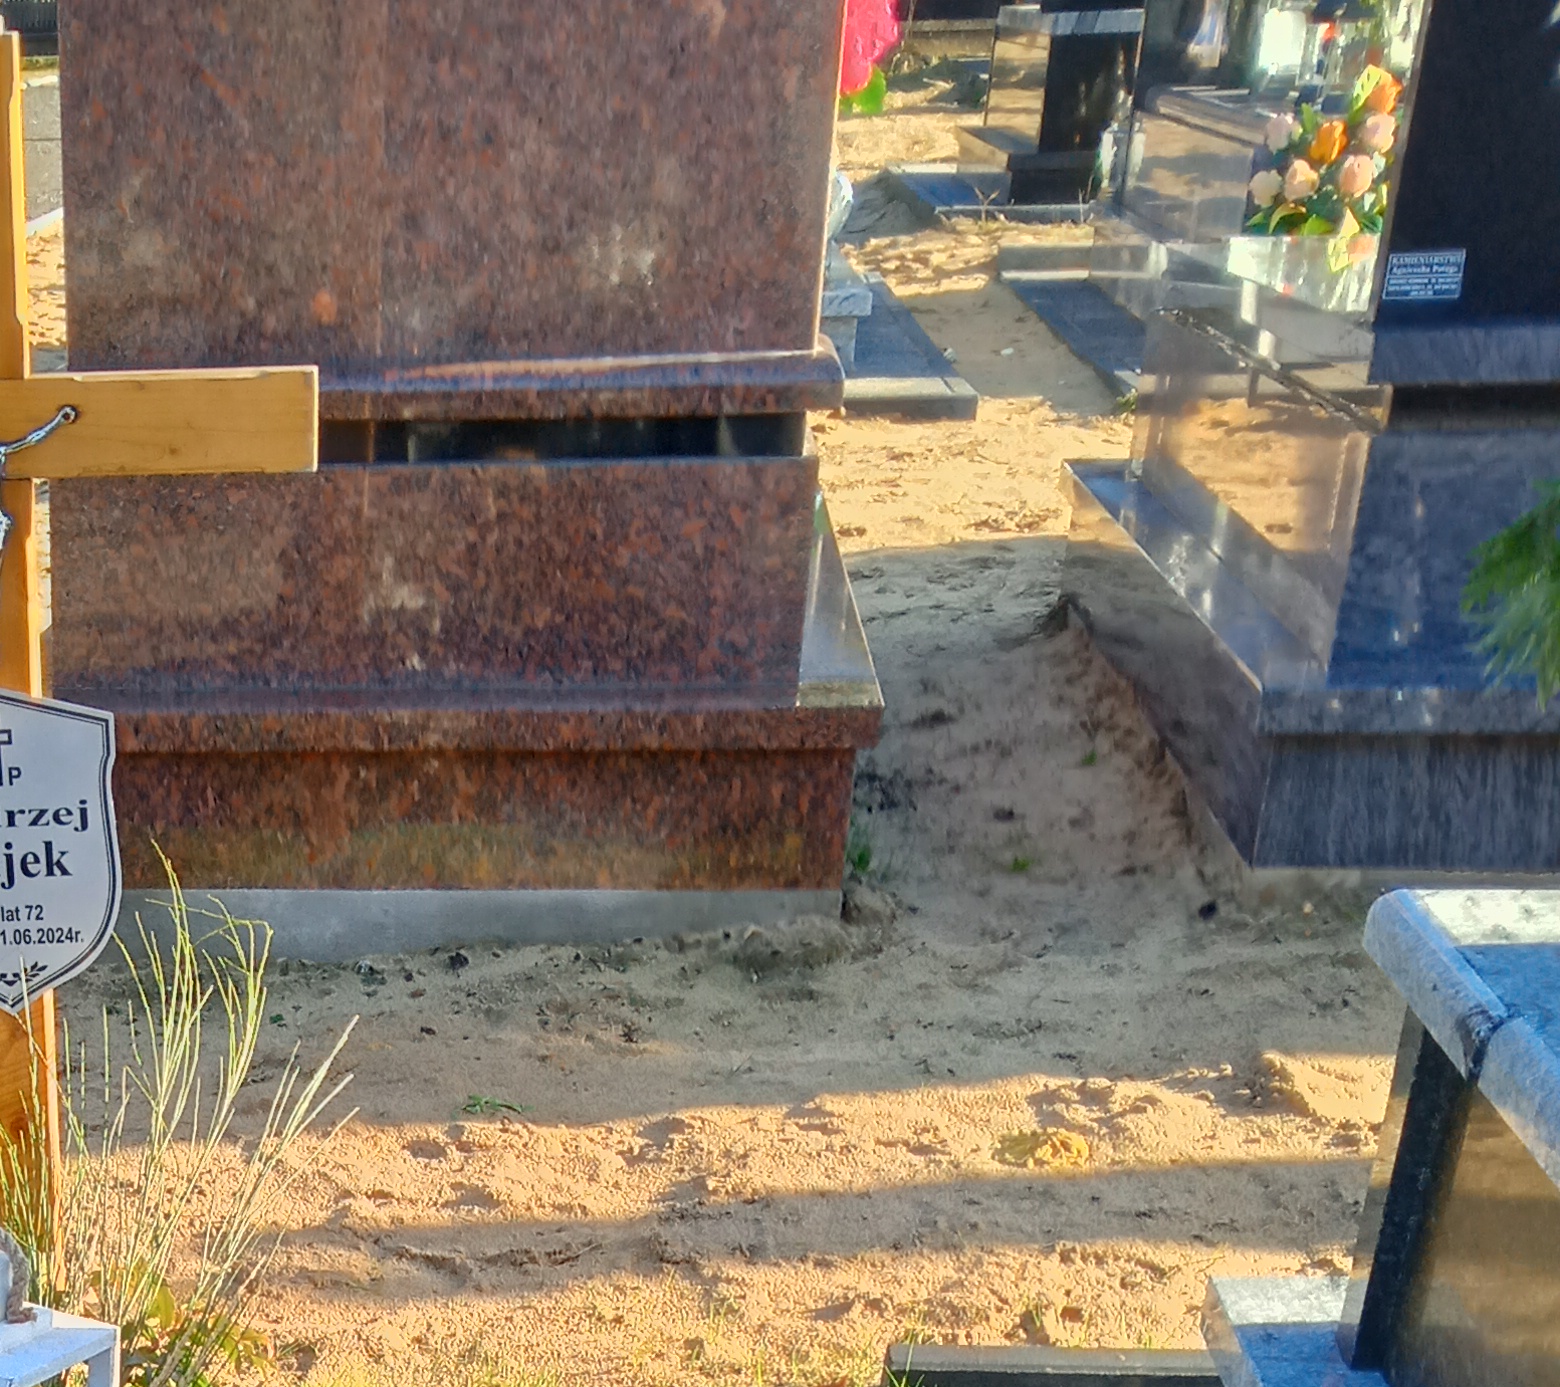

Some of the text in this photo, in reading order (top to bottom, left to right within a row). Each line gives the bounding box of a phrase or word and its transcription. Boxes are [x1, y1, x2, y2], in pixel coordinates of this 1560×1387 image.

[8, 767, 22, 786] P
[1, 905, 20, 922] lat
[25, 905, 44, 921] 72
